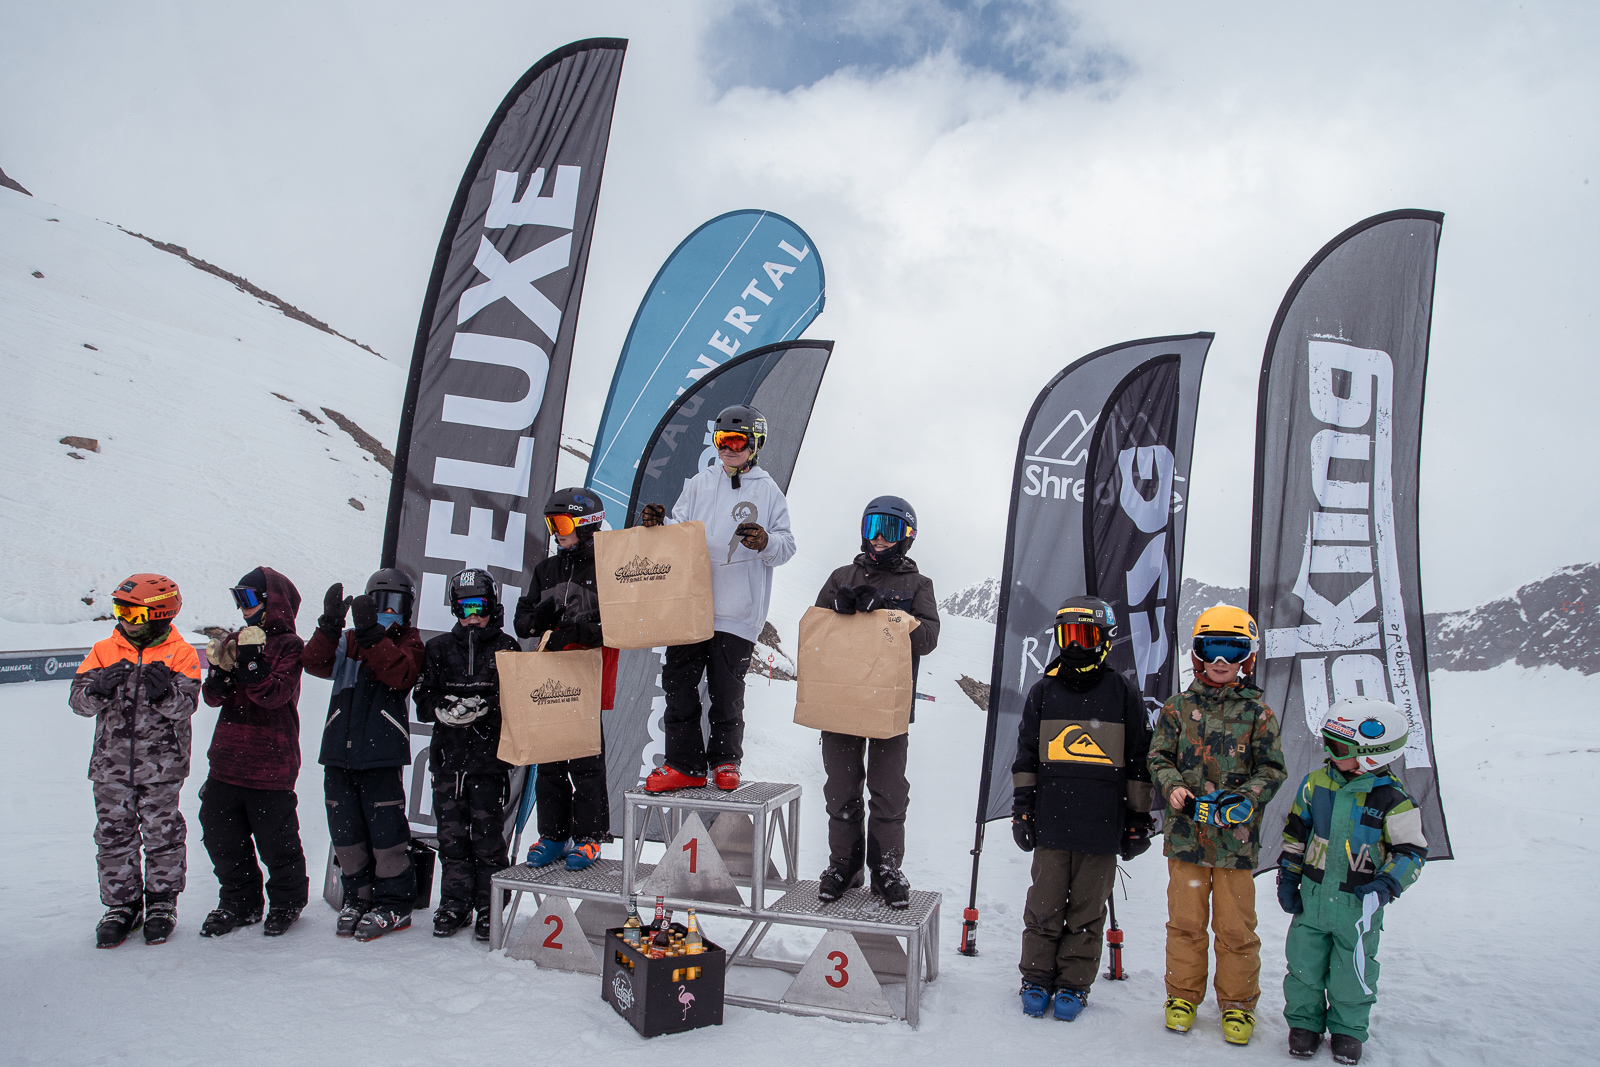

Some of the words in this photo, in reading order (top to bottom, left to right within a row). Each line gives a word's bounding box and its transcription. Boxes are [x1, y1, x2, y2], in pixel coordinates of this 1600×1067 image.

[0, 664, 33, 673] AUNERTAL
[1357, 745, 1391, 754] uvex
[683, 838, 698, 874] 1
[542, 914, 564, 950] 2
[824, 950, 849, 988] 3
